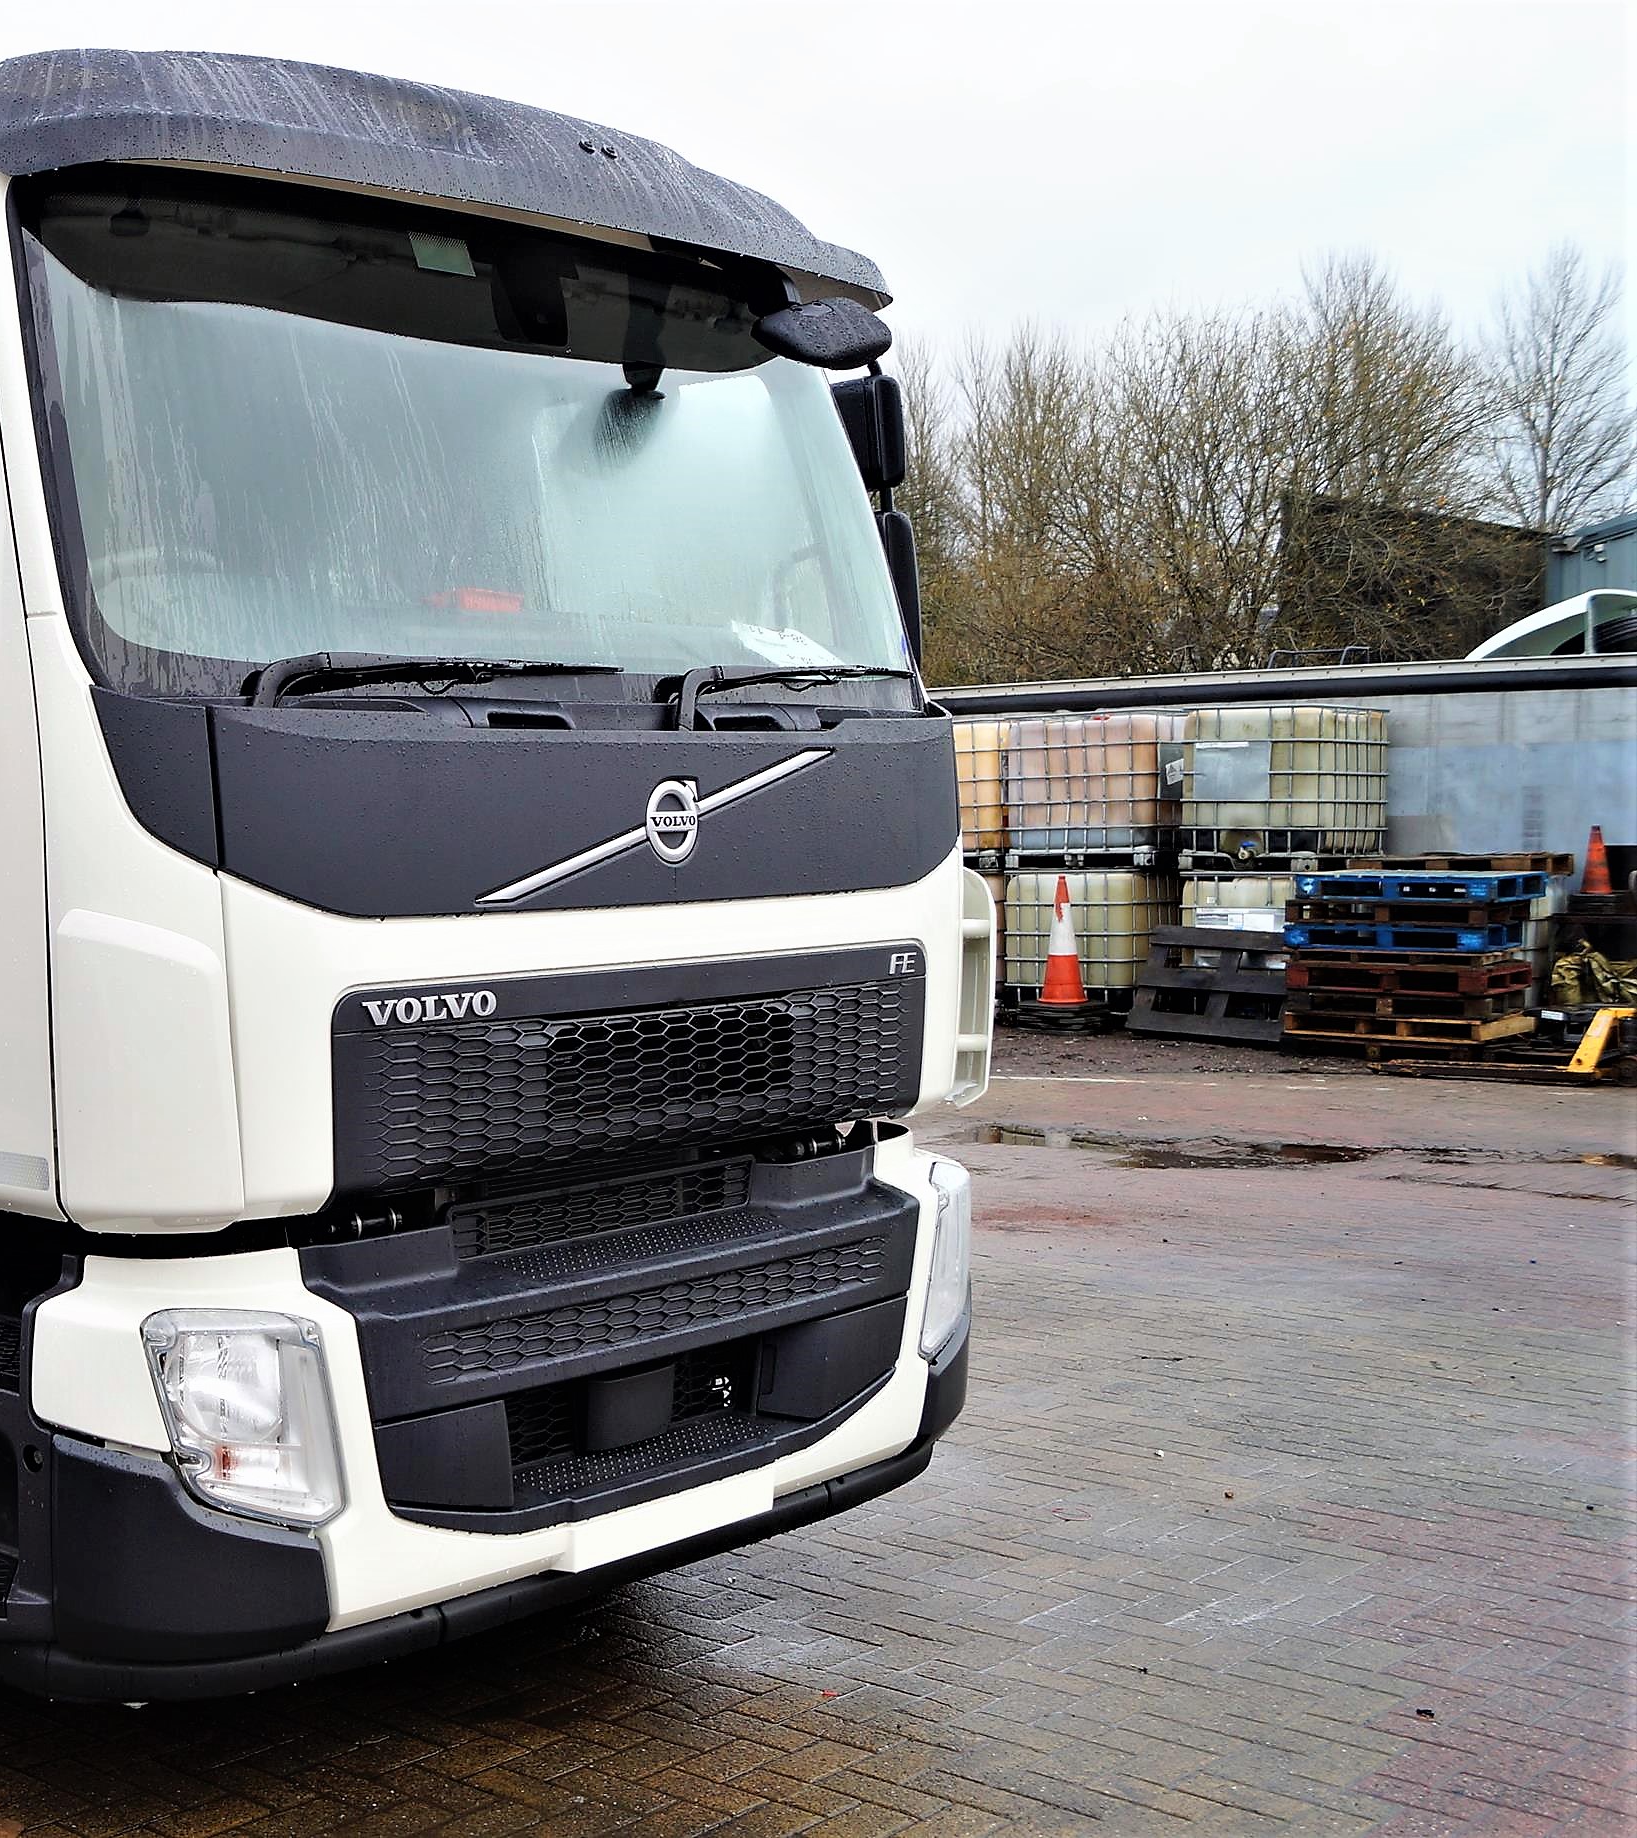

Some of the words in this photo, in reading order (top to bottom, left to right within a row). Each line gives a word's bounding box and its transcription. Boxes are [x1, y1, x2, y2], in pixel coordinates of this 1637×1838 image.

[650, 815, 696, 827] VOLVO
[889, 952, 917, 975] FE
[362, 990, 497, 1026] VOLVO
